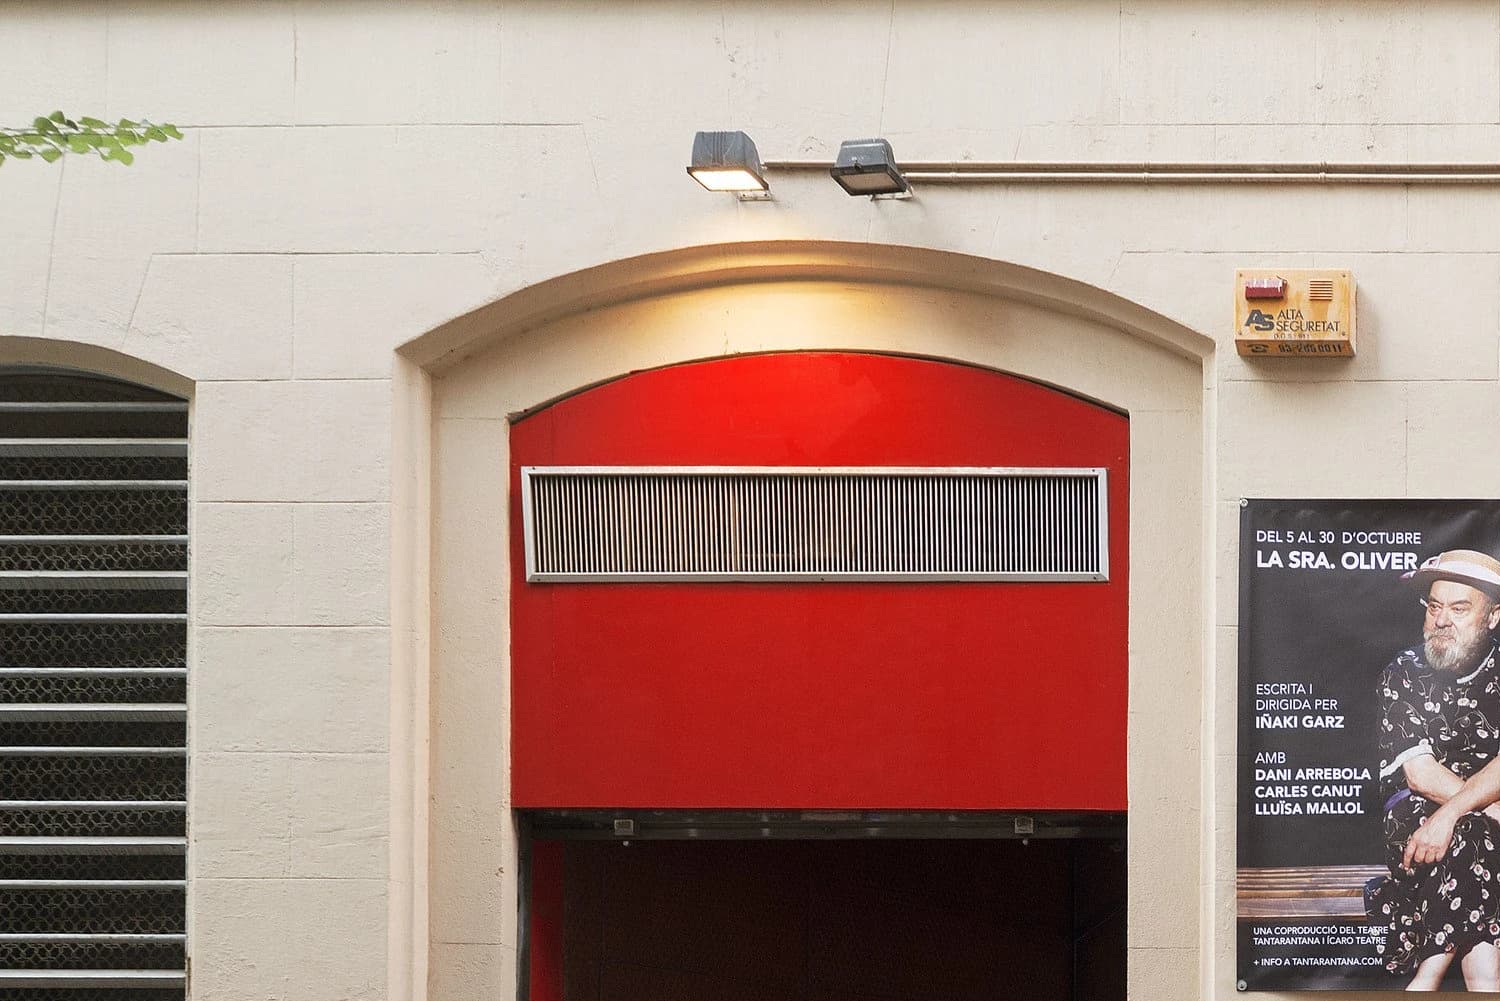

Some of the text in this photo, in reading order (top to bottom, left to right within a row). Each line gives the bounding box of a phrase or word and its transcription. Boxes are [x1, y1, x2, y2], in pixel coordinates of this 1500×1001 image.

[1277, 309, 1304, 320] ALTA
[1276, 321, 1340, 332] SEGURETAT
[1256, 530, 1283, 543] DEL
[1286, 530, 1295, 543] 5
[1298, 531, 1316, 544] AL
[1318, 531, 1335, 544] 30
[1256, 550, 1418, 570] LA SRA. OLIVER
[1256, 683, 1313, 695] ESCRITA I
[1255, 699, 1338, 711] DIRIGIDA PER
[1255, 713, 1345, 729] IÑAKI GARZ
[1255, 752, 1286, 764] AMB
[1255, 768, 1371, 781] DANI ARREBOLA
[1255, 785, 1362, 798] CARLES CANUT
[1306, 802, 1365, 815] MALLOL
[1253, 925, 1389, 935] UNA COPRODUCCIÓ DEL TEATRE
[1253, 937, 1320, 945] TANTARANTANA
[1326, 935, 1354, 945] ÍCARO
[1356, 936, 1387, 944] TEATRE
[1261, 958, 1282, 966] INFO
[1283, 958, 1291, 966] A
[1292, 957, 1383, 966] TANTARANTANA.COM
